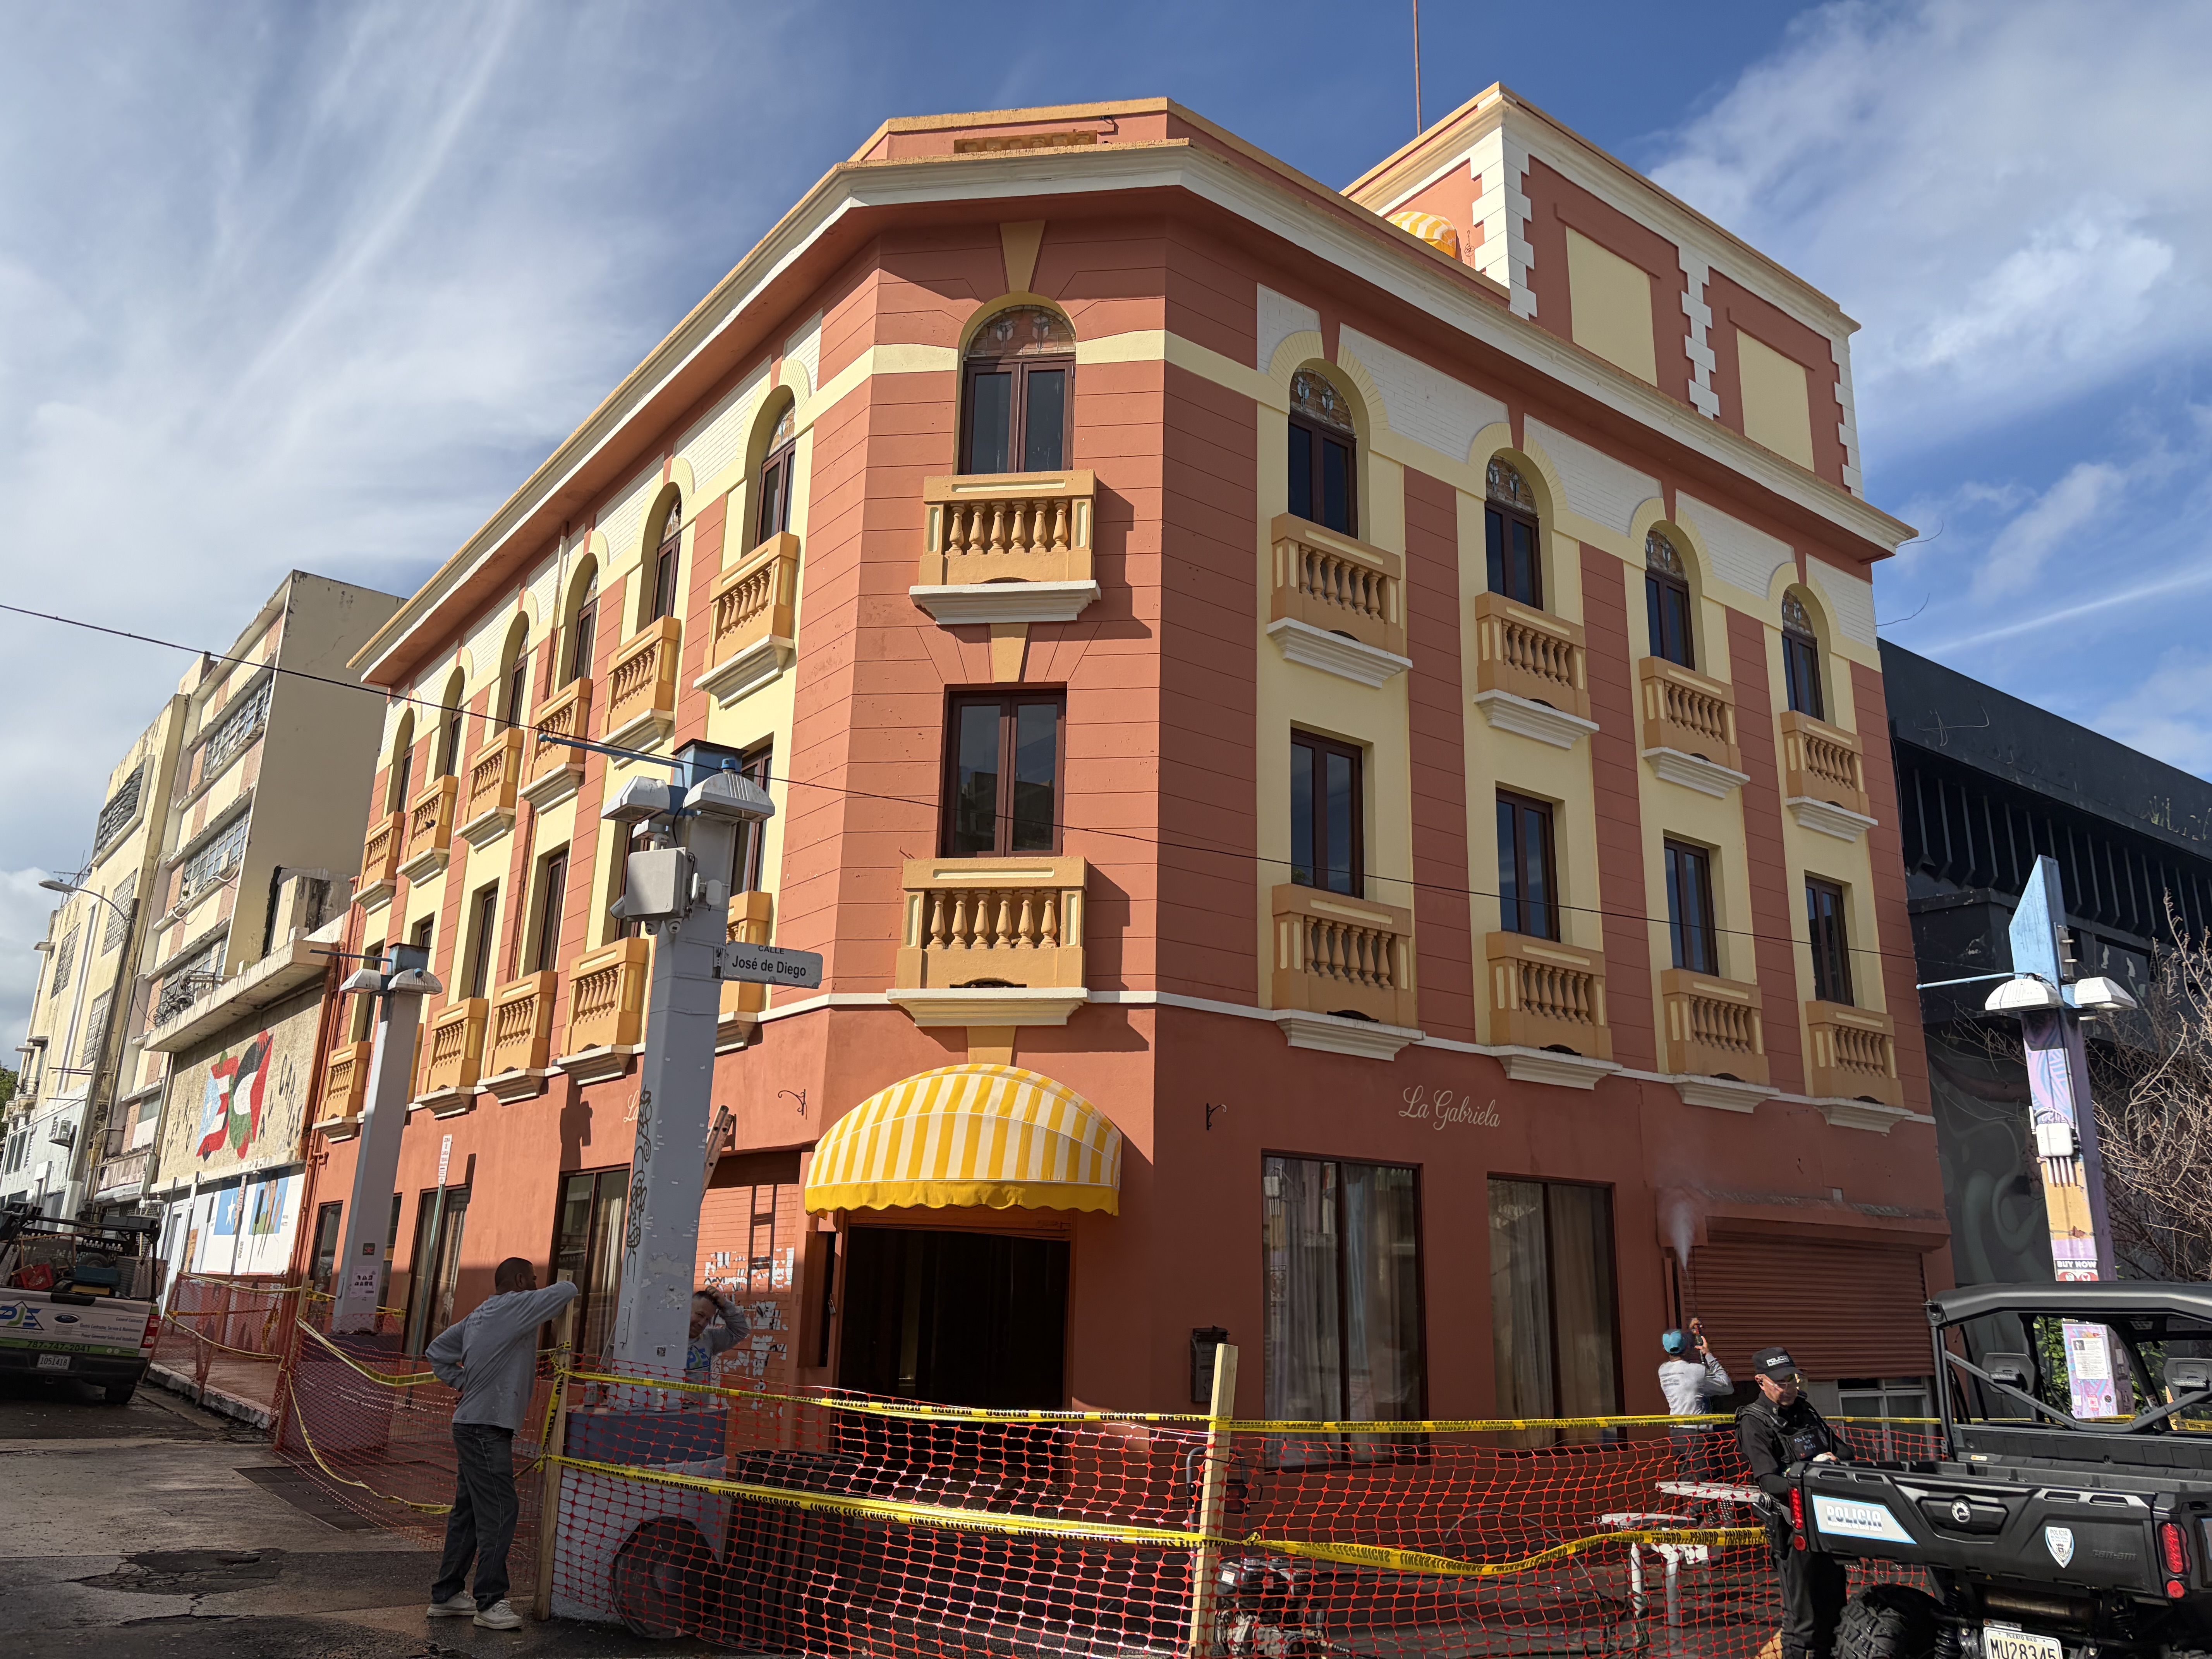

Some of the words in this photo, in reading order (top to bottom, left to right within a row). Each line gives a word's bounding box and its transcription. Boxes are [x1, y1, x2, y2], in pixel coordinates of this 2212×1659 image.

[758, 945, 785, 955] CALLE
[732, 955, 758, 970] José
[761, 959, 773, 972] de
[776, 961, 806, 979] Diego
[1398, 1085, 1430, 1118] La
[1433, 1090, 1500, 1130] Gabriela
[27, 1341, 91, 1352] 787-747-2041
[40, 1357, 67, 1366] 1051418
[810, 1502, 841, 1516] LINEAS
[842, 1508, 900, 1523] ELECTRICAS
[909, 1515, 944, 1528] LINEAS
[945, 1519, 1007, 1534] ELECTRICAS
[1826, 1505, 1882, 1527] POLICIA
